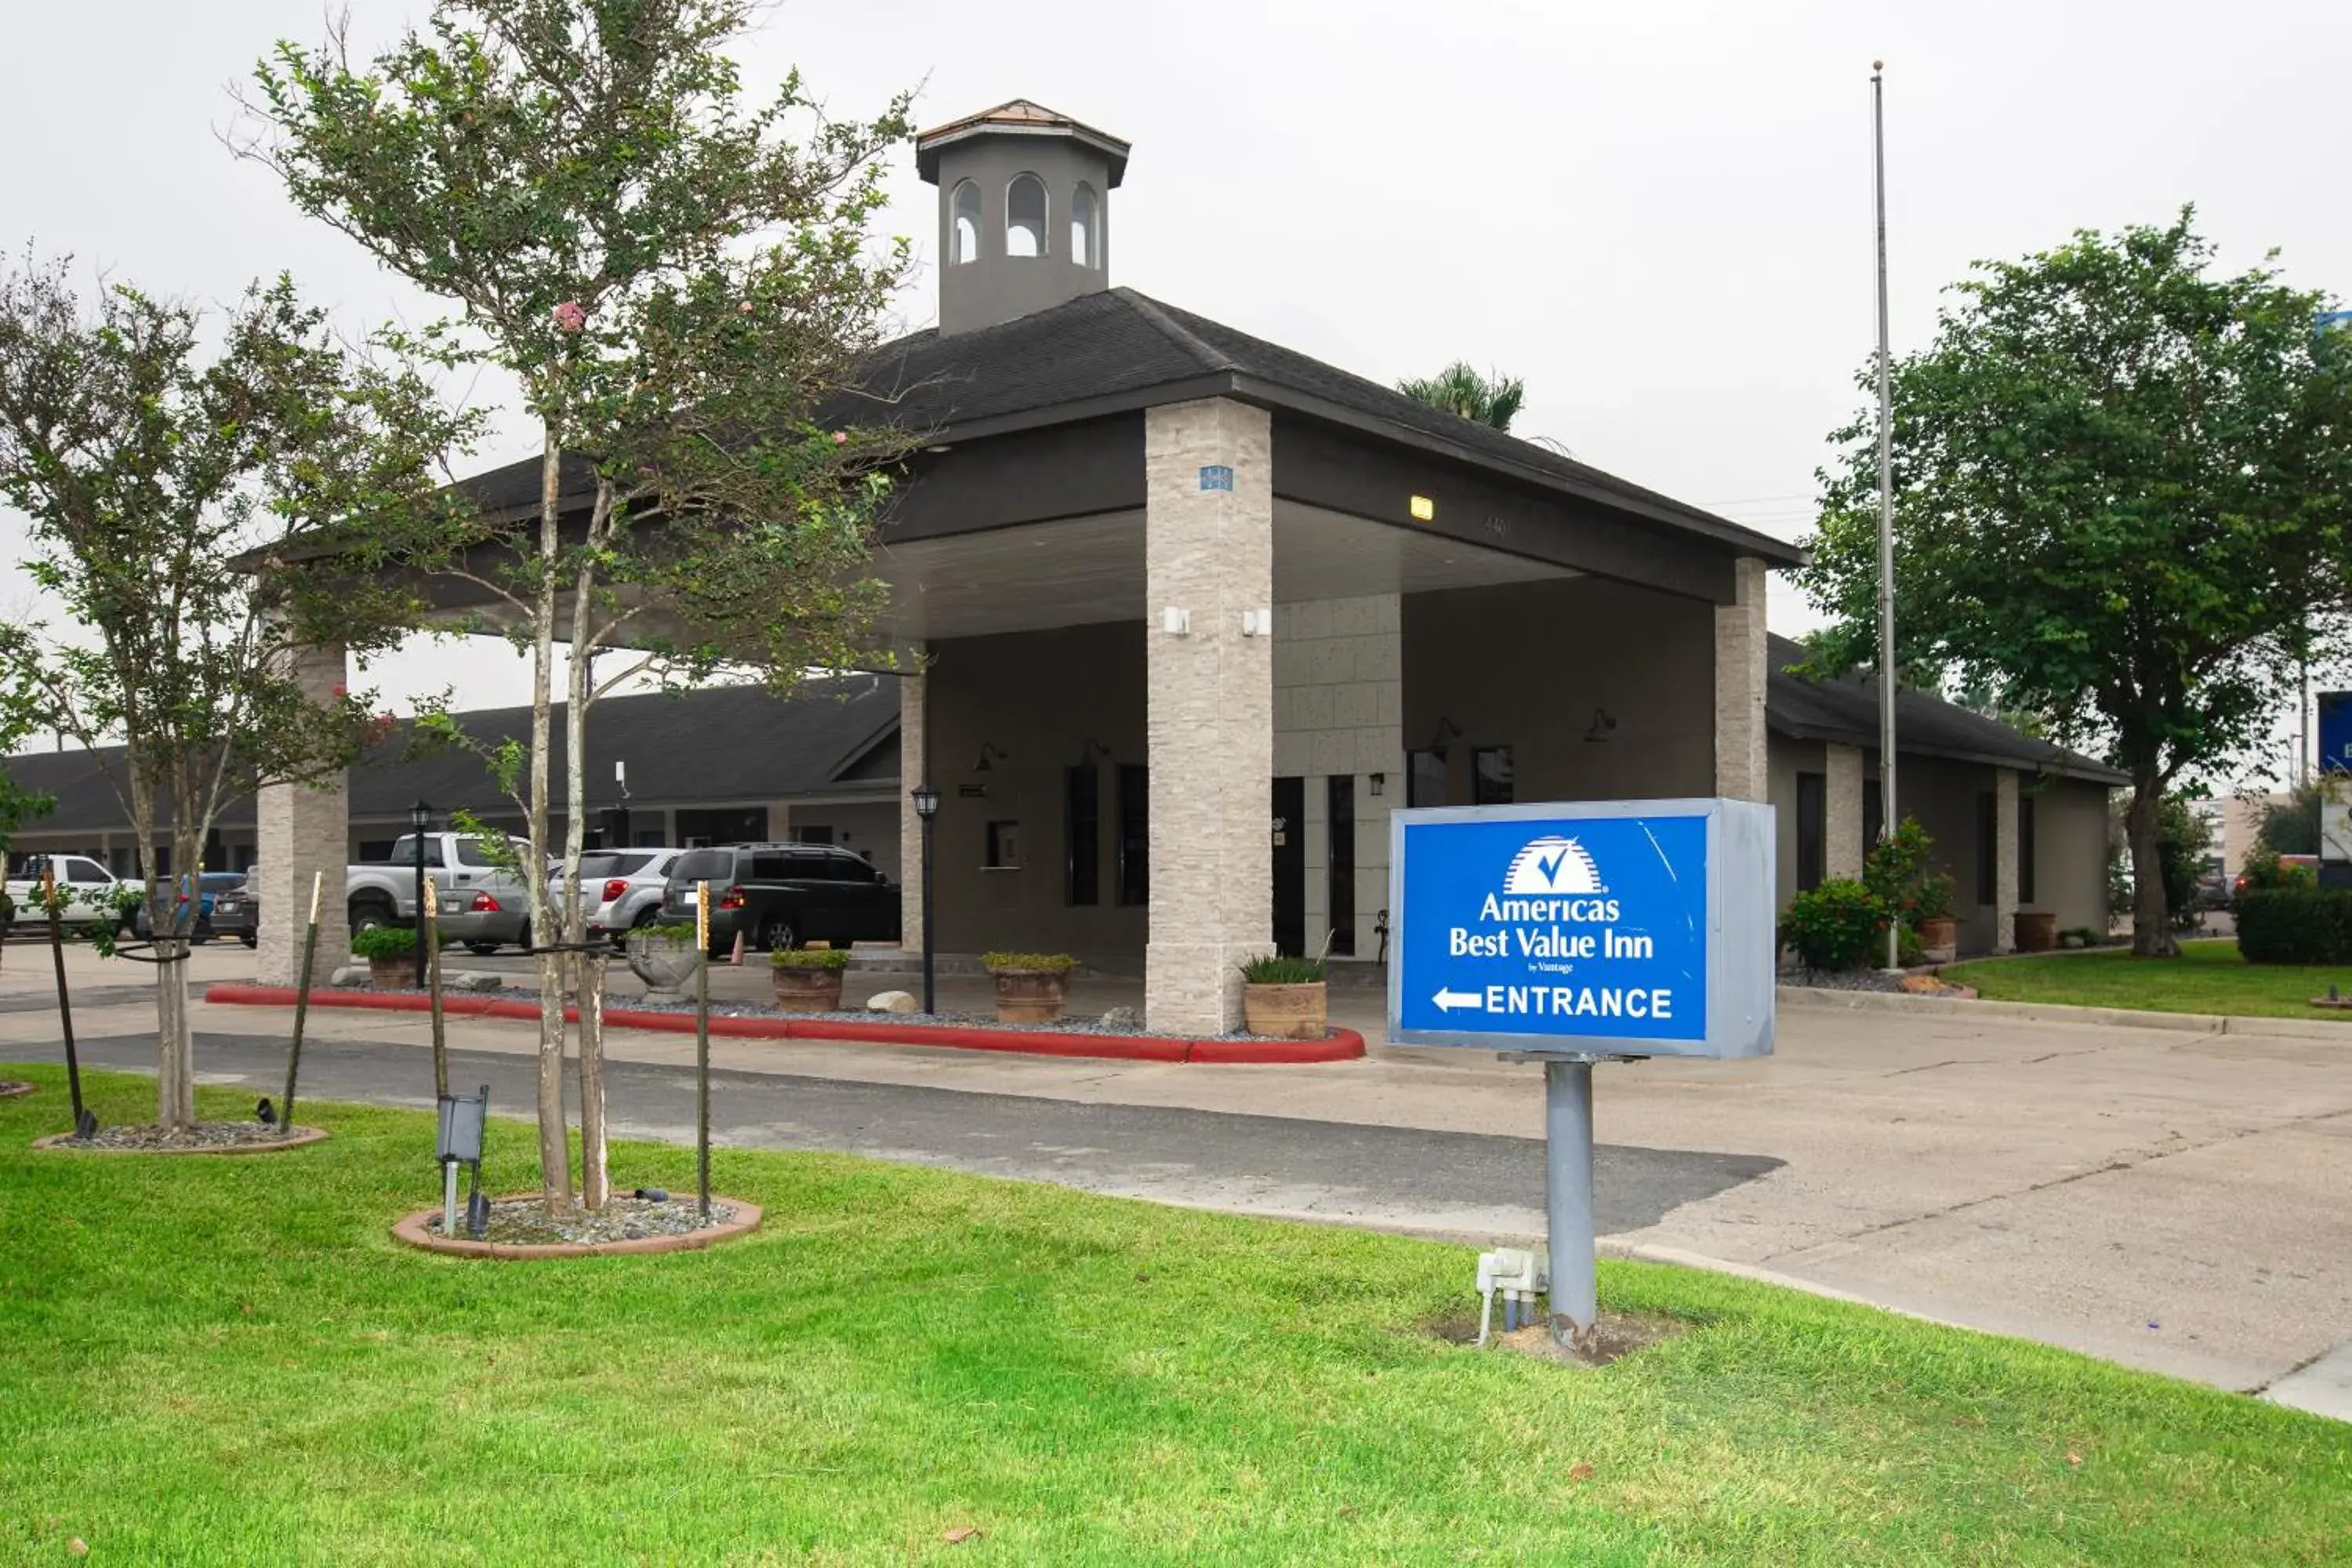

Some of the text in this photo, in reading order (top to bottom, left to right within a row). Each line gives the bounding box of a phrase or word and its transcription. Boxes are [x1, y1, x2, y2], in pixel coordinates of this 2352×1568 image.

[1479, 892, 1620, 922] Americas
[1450, 925, 1653, 958] Best Value Inn
[1528, 961, 1574, 975] by Vantage
[1486, 985, 1672, 1018] ENTRANCE
